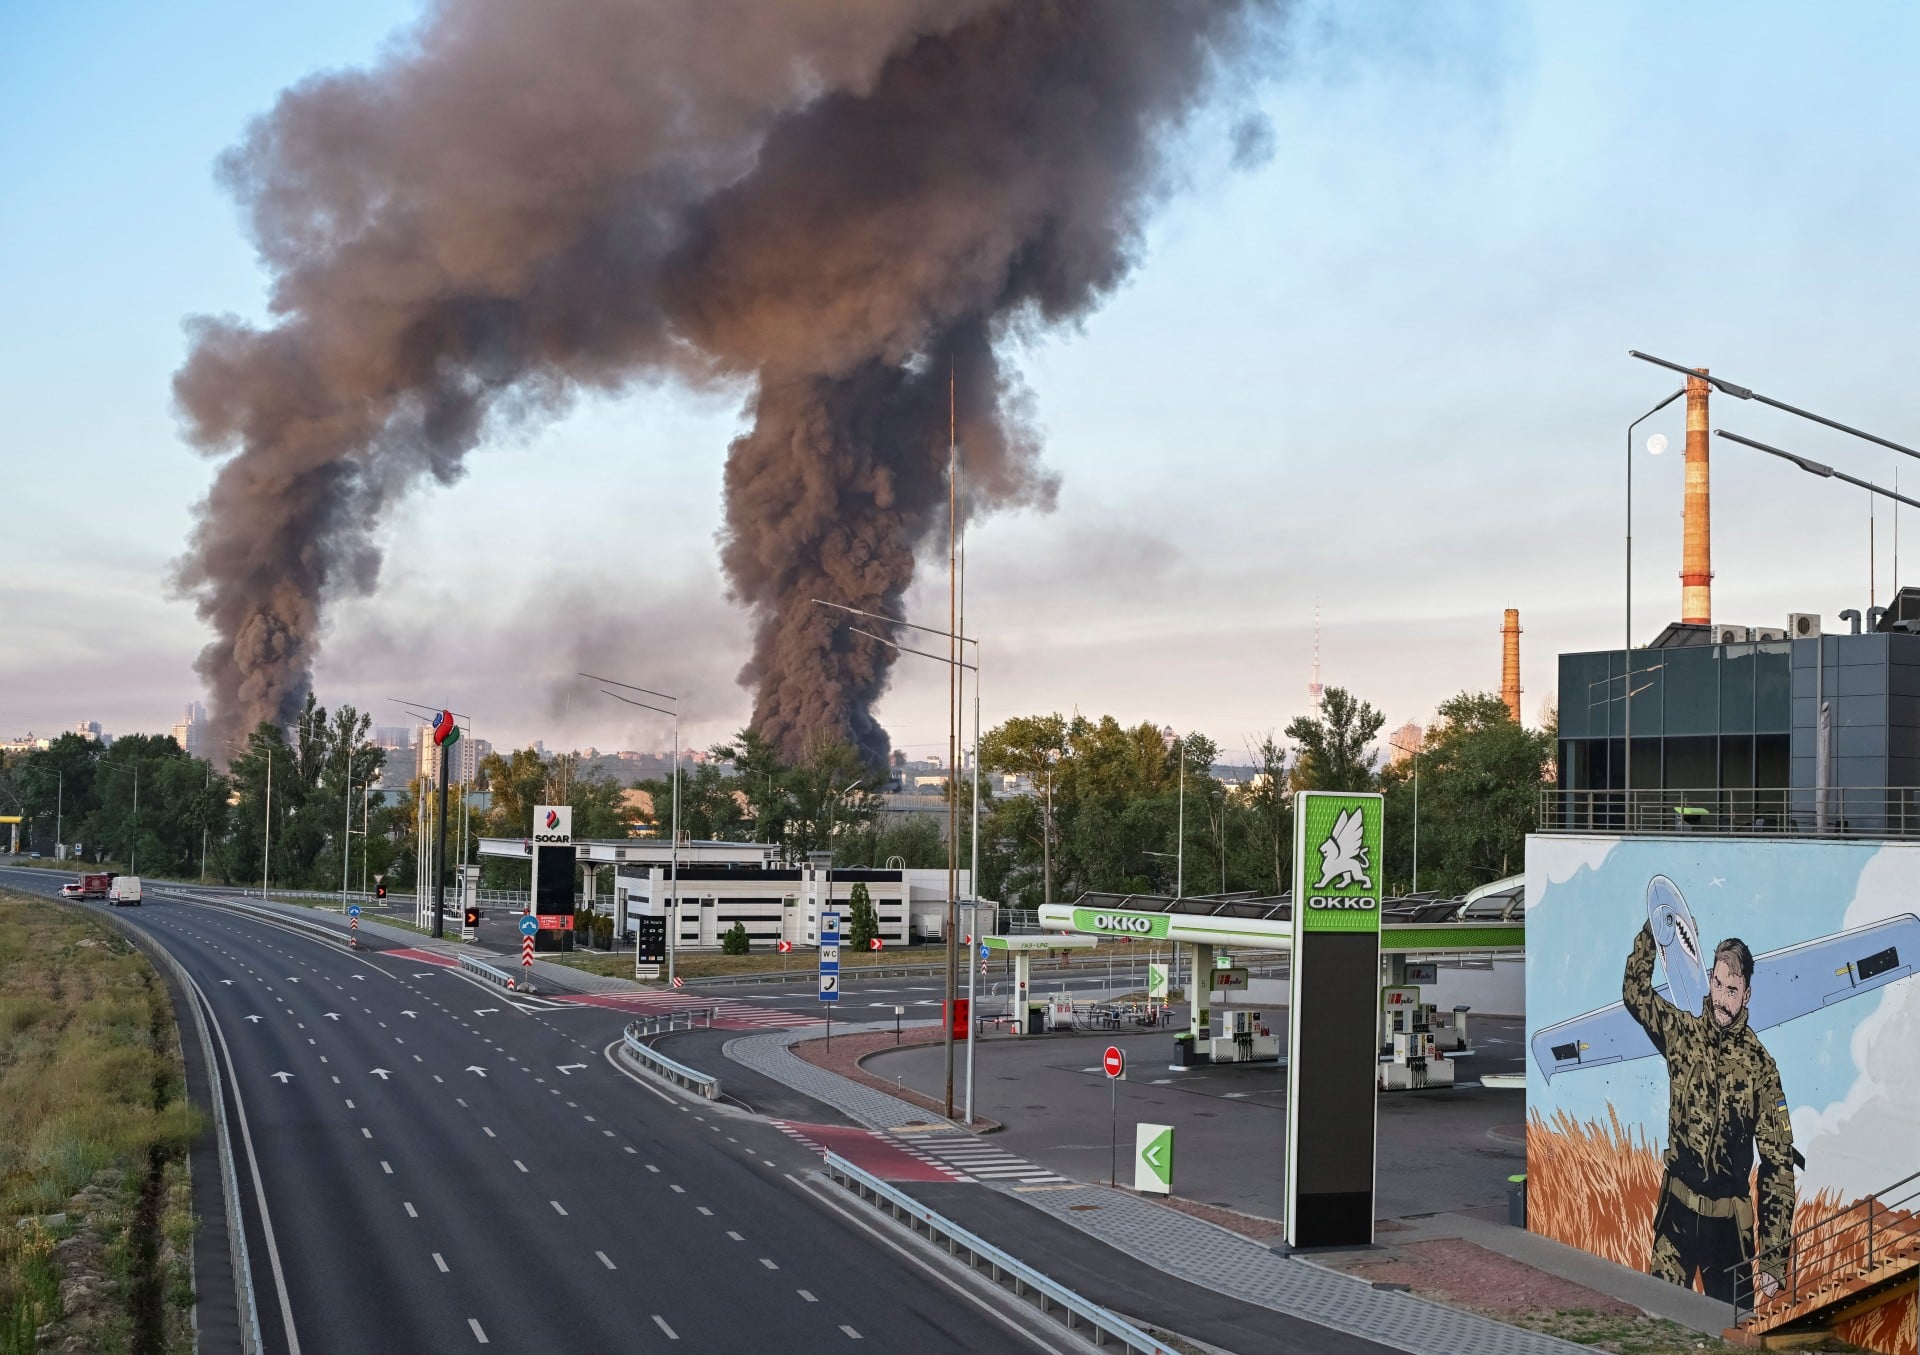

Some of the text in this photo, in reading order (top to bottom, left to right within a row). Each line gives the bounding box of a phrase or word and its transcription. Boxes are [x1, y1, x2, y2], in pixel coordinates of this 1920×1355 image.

[535, 835, 570, 843] SOCAR
[1309, 896, 1376, 909] OKKO
[1094, 915, 1152, 933] OKKO
